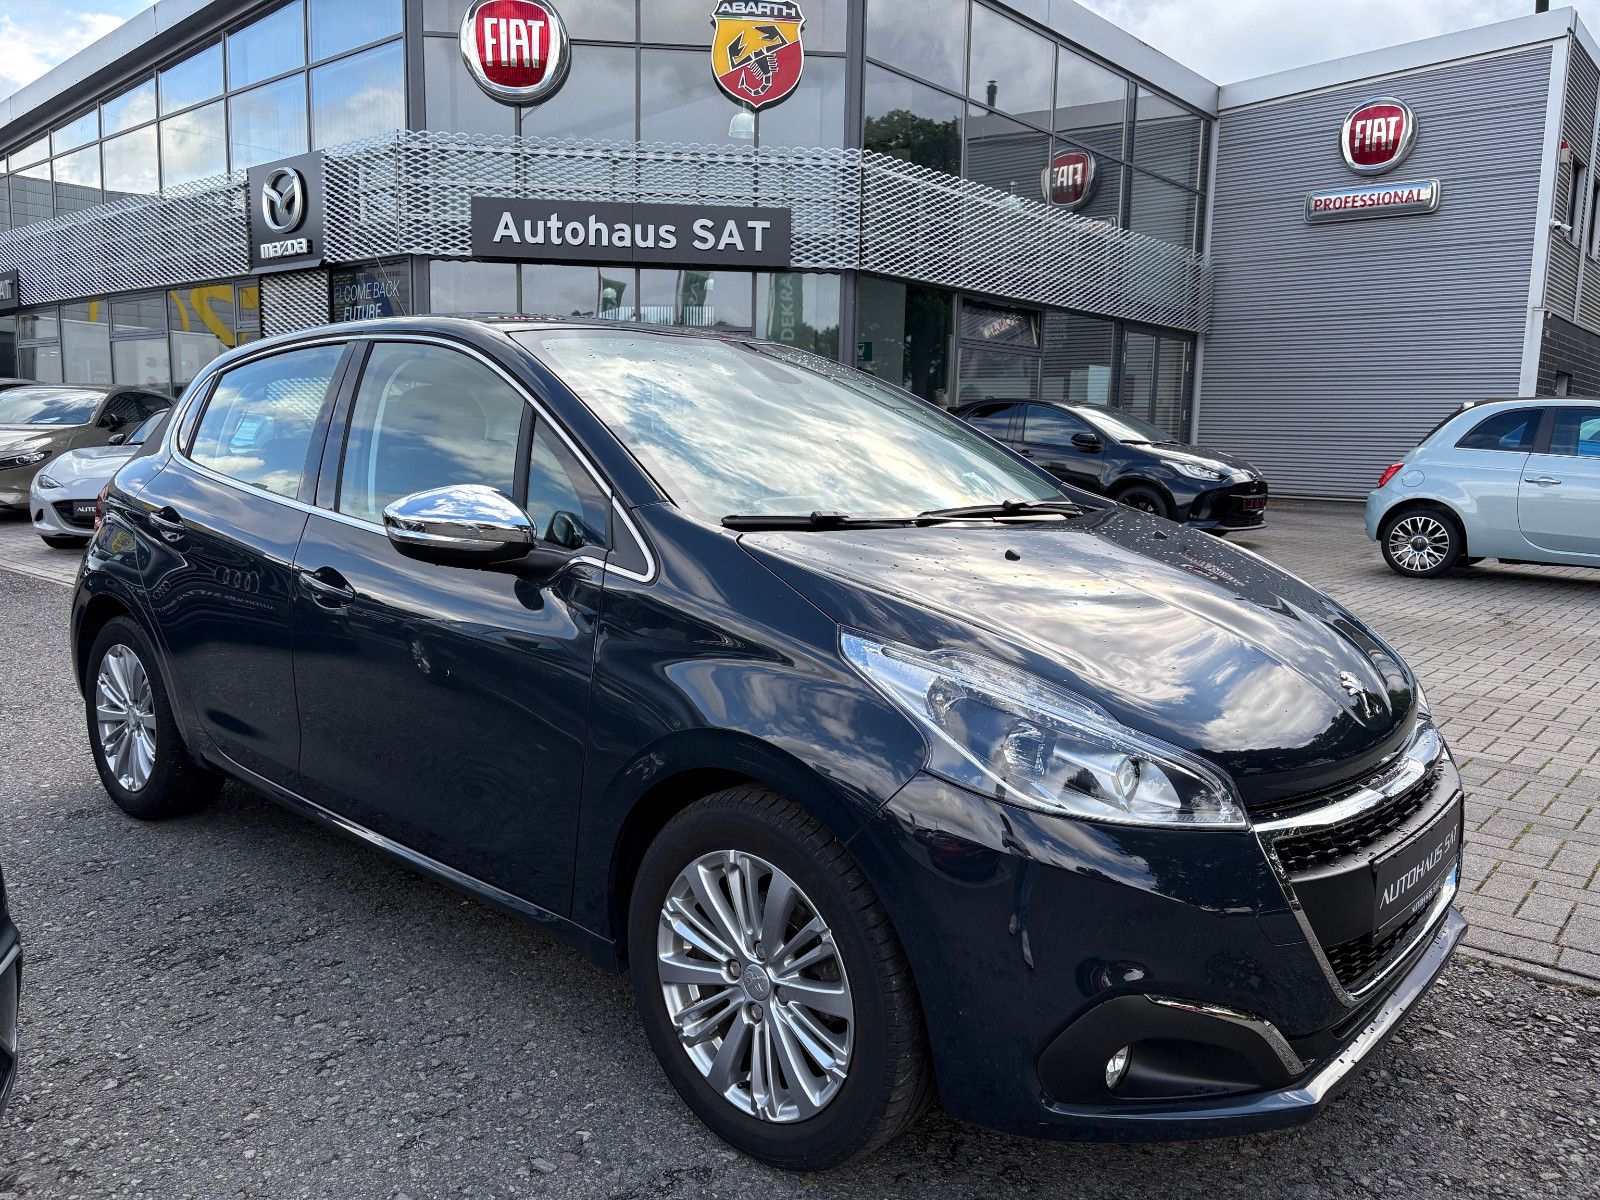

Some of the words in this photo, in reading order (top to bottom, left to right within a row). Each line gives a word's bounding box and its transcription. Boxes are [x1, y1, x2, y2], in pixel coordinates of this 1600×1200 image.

[719, 2, 796, 17] ABARTH
[484, 17, 545, 68] FIAT
[1354, 116, 1400, 154] FIAT
[1312, 188, 1425, 212] PROFESSIONAL
[493, 211, 677, 249] Autohaus
[692, 217, 771, 252] SAT
[334, 283, 373, 303] ELCOME
[373, 280, 400, 299] BACK
[780, 273, 796, 342] DEKRA
[1379, 842, 1444, 911] AUTOHAUS
